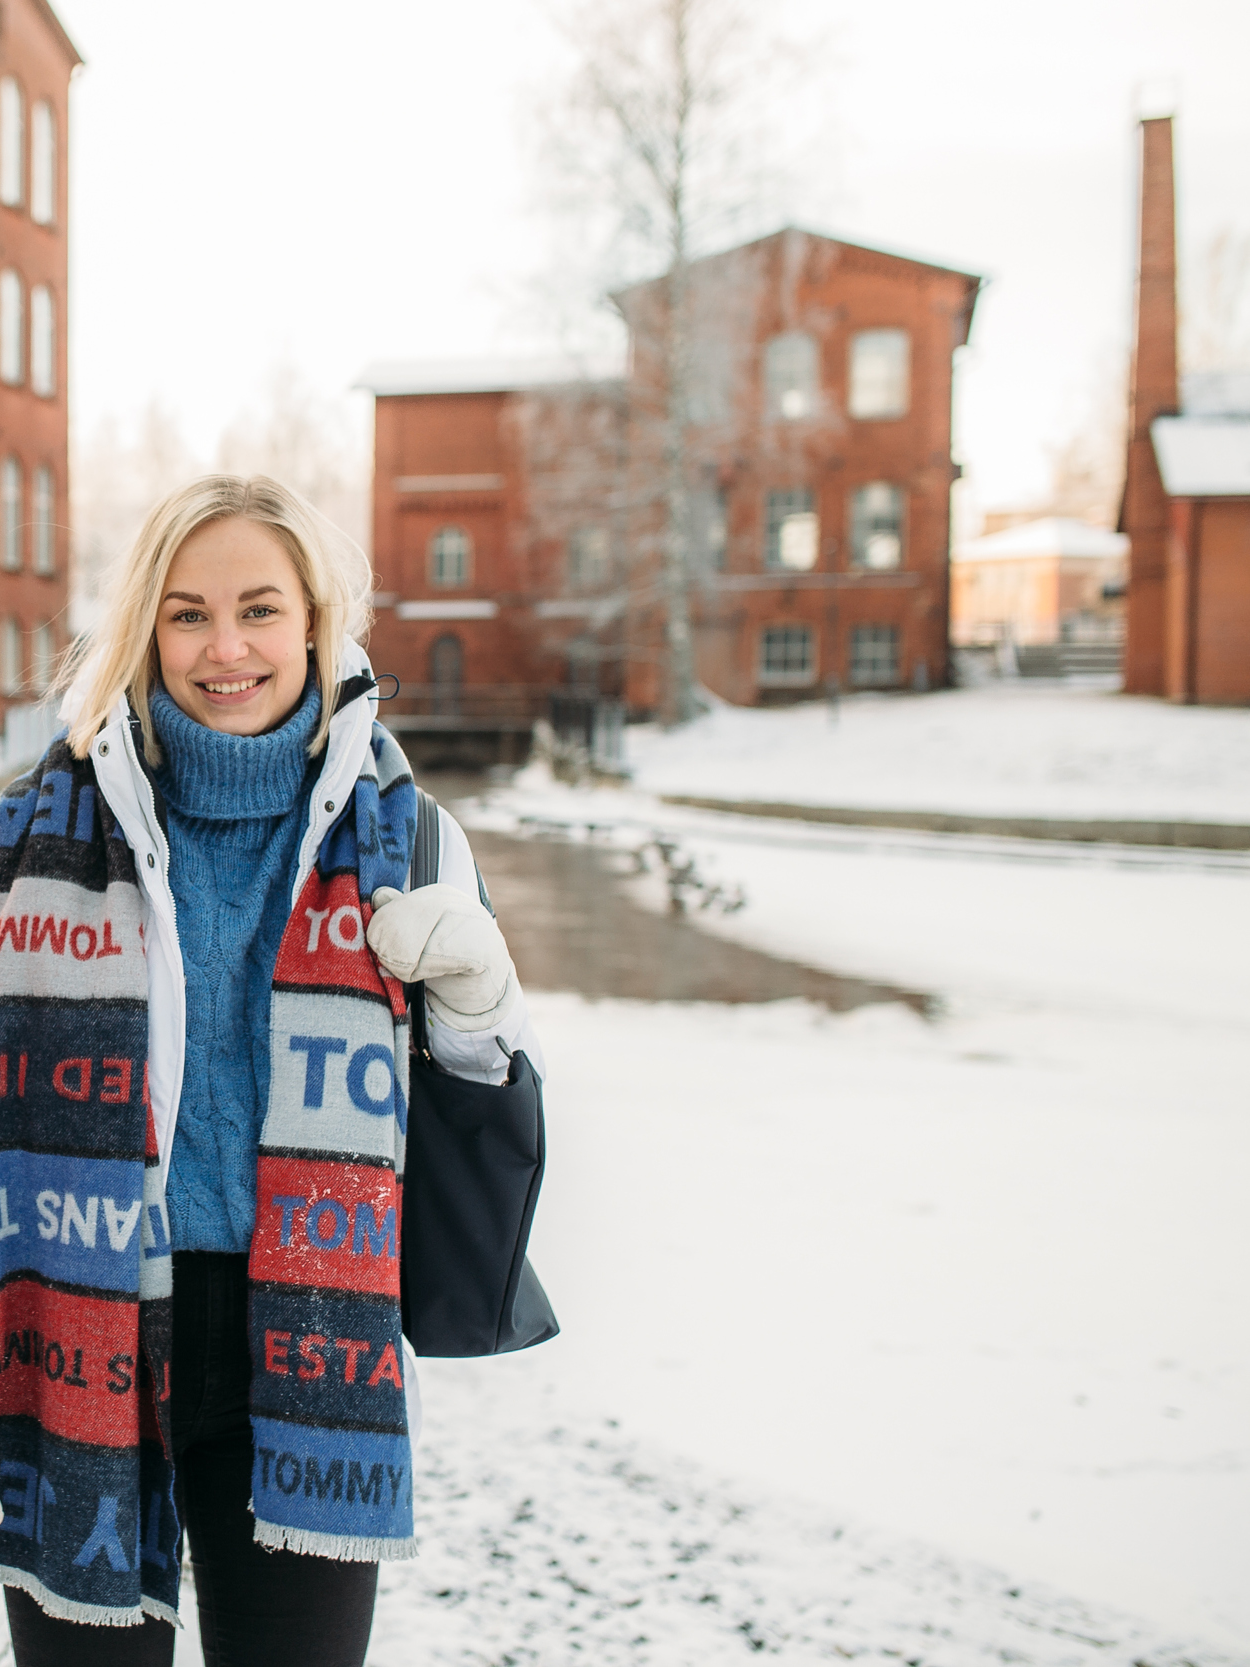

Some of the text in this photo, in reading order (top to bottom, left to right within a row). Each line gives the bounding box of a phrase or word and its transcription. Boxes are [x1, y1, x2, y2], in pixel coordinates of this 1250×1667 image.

[52, 1055, 150, 1106] ED
[35, 1189, 142, 1253] ANS
[271, 1193, 397, 1258] TOM
[264, 1328, 403, 1391] ESTA
[257, 1445, 404, 1511] TOMMY
